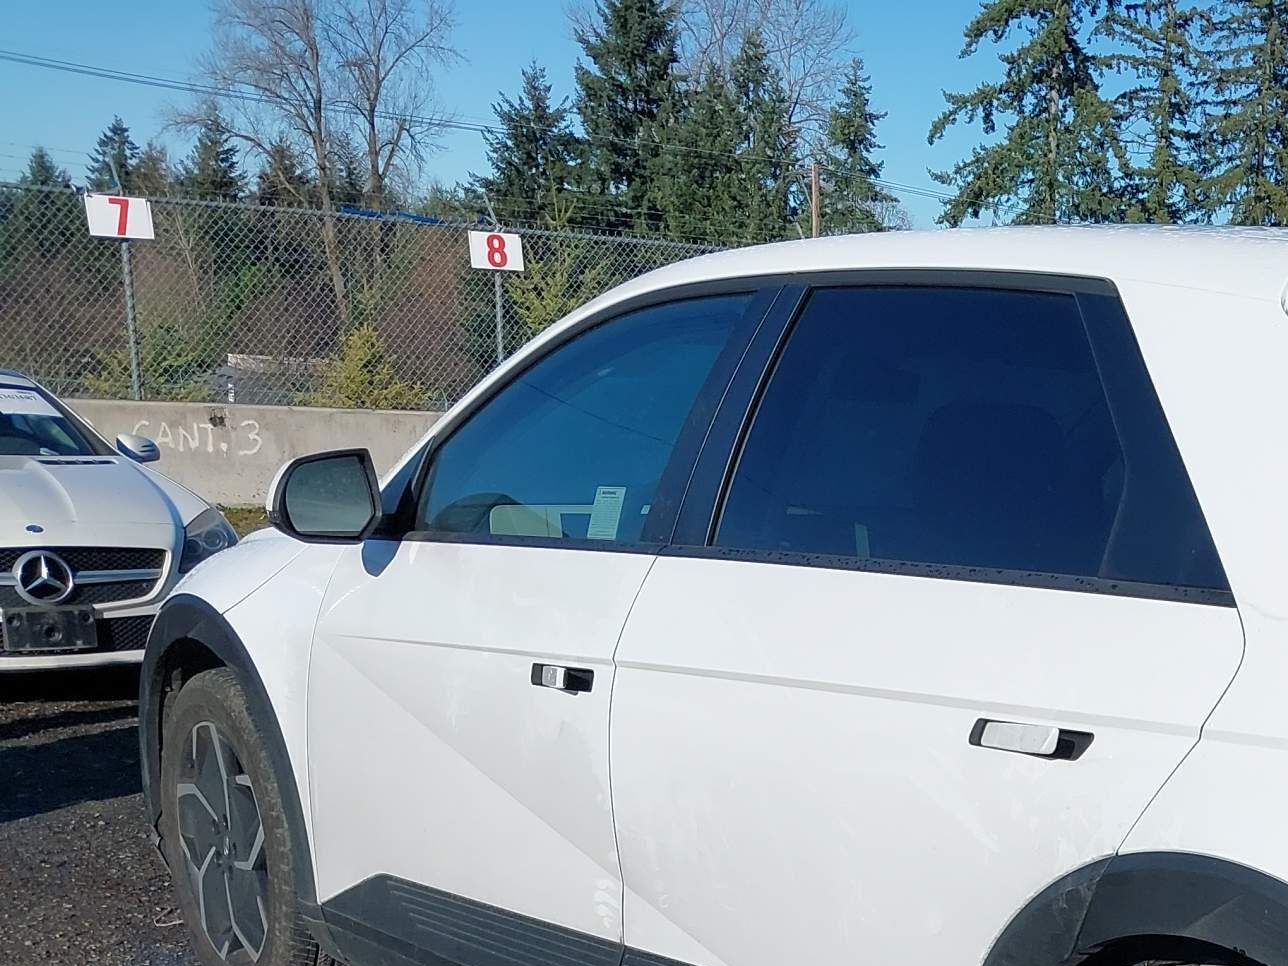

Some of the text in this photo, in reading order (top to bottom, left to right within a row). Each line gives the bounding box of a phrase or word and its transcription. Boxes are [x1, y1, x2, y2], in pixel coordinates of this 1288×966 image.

[108, 197, 129, 236] 7
[486, 234, 508, 268] 8
[238, 419, 263, 455] 3
